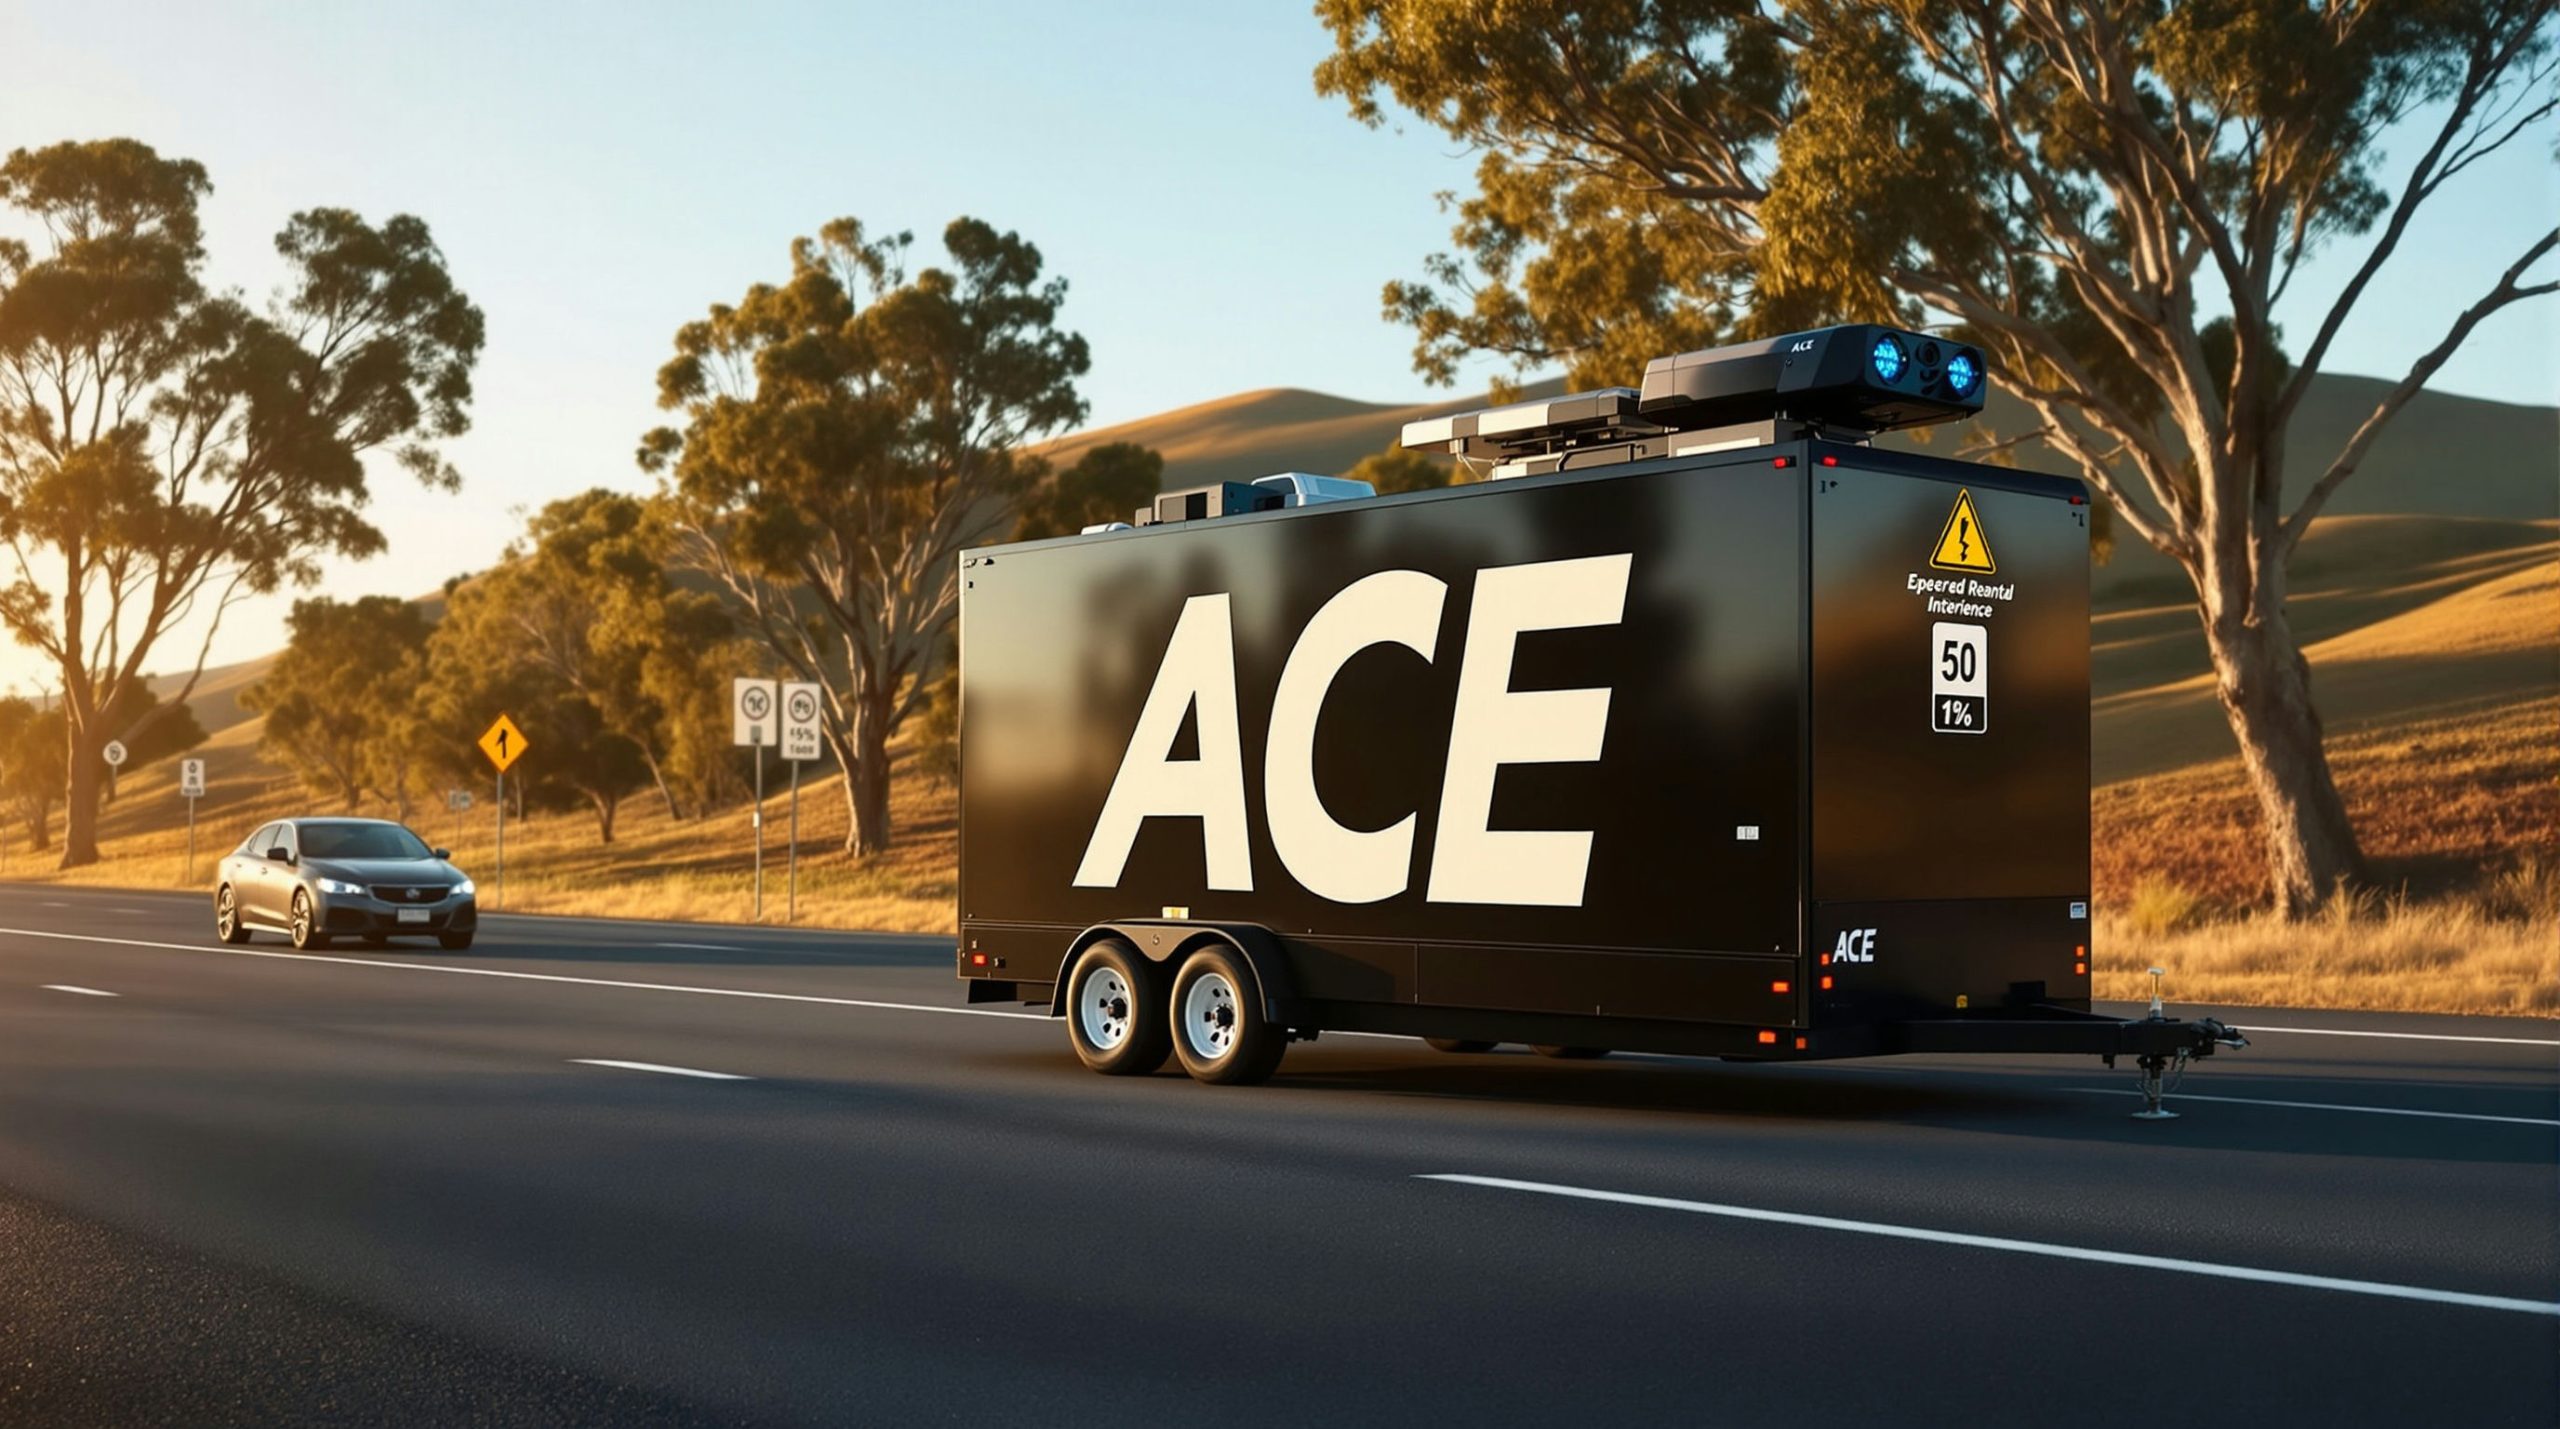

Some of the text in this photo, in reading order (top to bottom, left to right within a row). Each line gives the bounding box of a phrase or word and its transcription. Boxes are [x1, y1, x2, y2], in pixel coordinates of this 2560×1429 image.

[1791, 339, 1815, 353] ACE
[1941, 639, 1977, 683] 50
[1072, 553, 1633, 907] ACE
[1941, 699, 1972, 727] 1%
[1832, 928, 1877, 963] ACE
